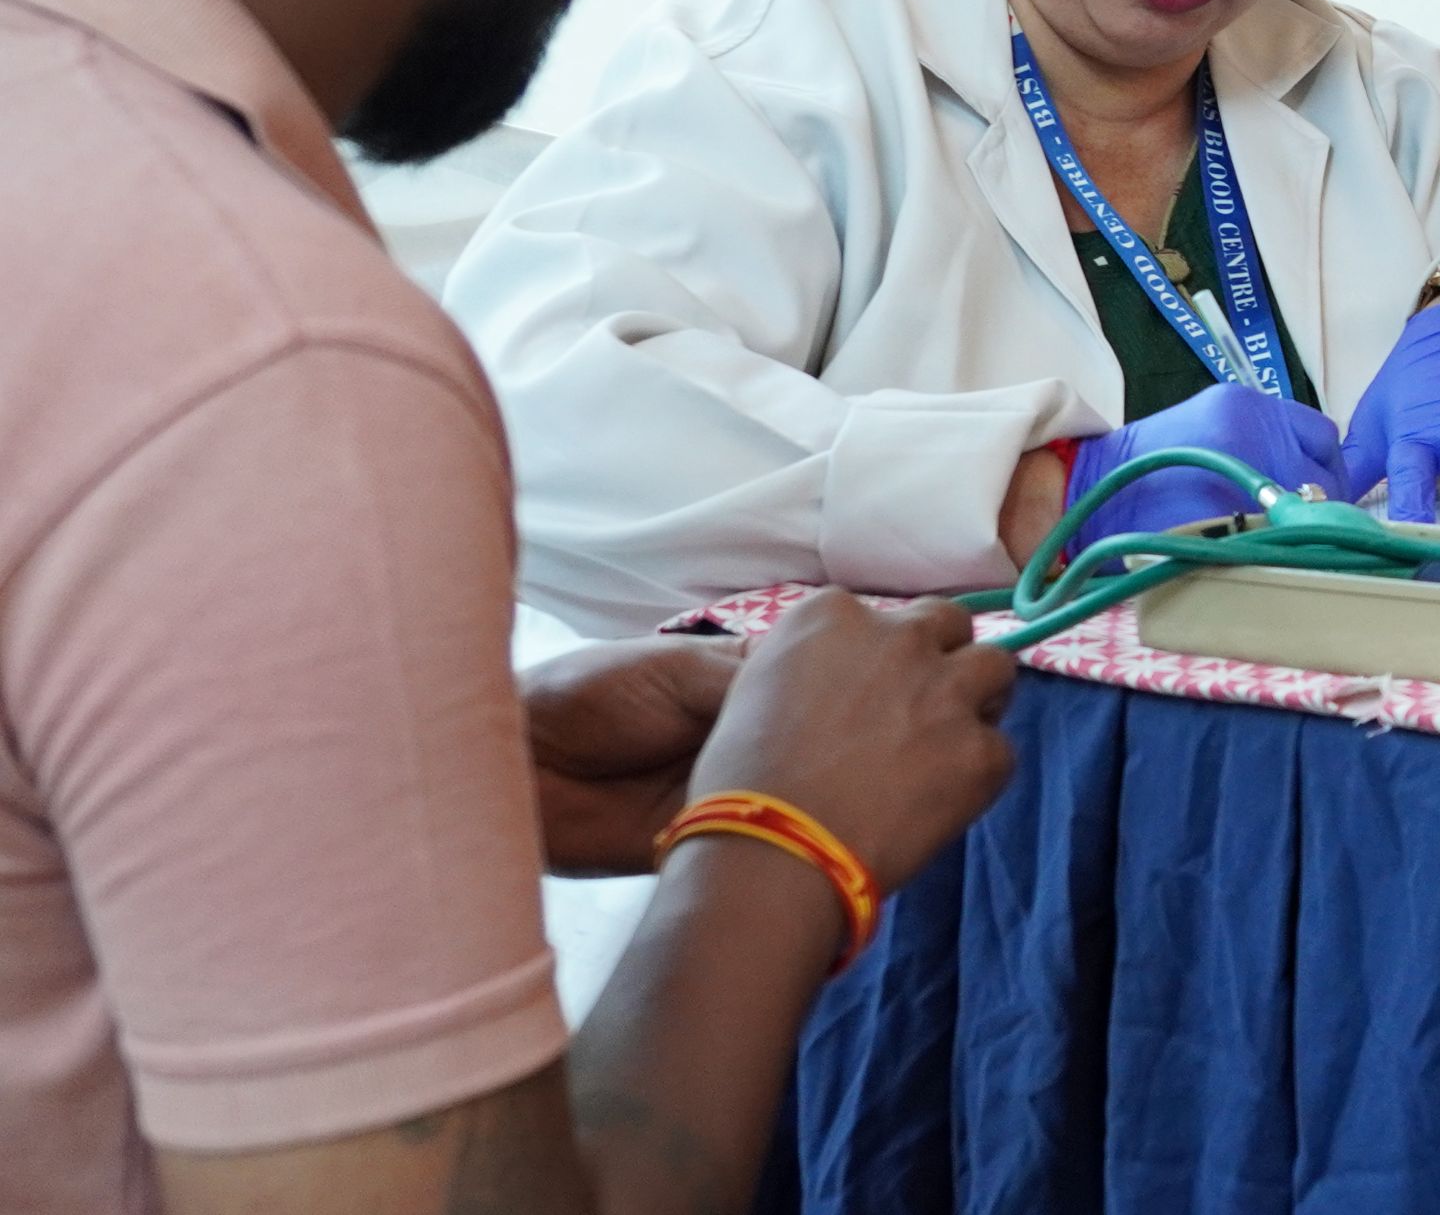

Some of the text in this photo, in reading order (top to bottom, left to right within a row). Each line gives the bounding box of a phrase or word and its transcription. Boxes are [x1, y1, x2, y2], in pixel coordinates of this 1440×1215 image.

[1055, 153, 1136, 249] CENTRE
[1203, 128, 1236, 215] BLOOD
[1133, 254, 1207, 338] BLOOD
[1217, 221, 1259, 313] CENTRE
